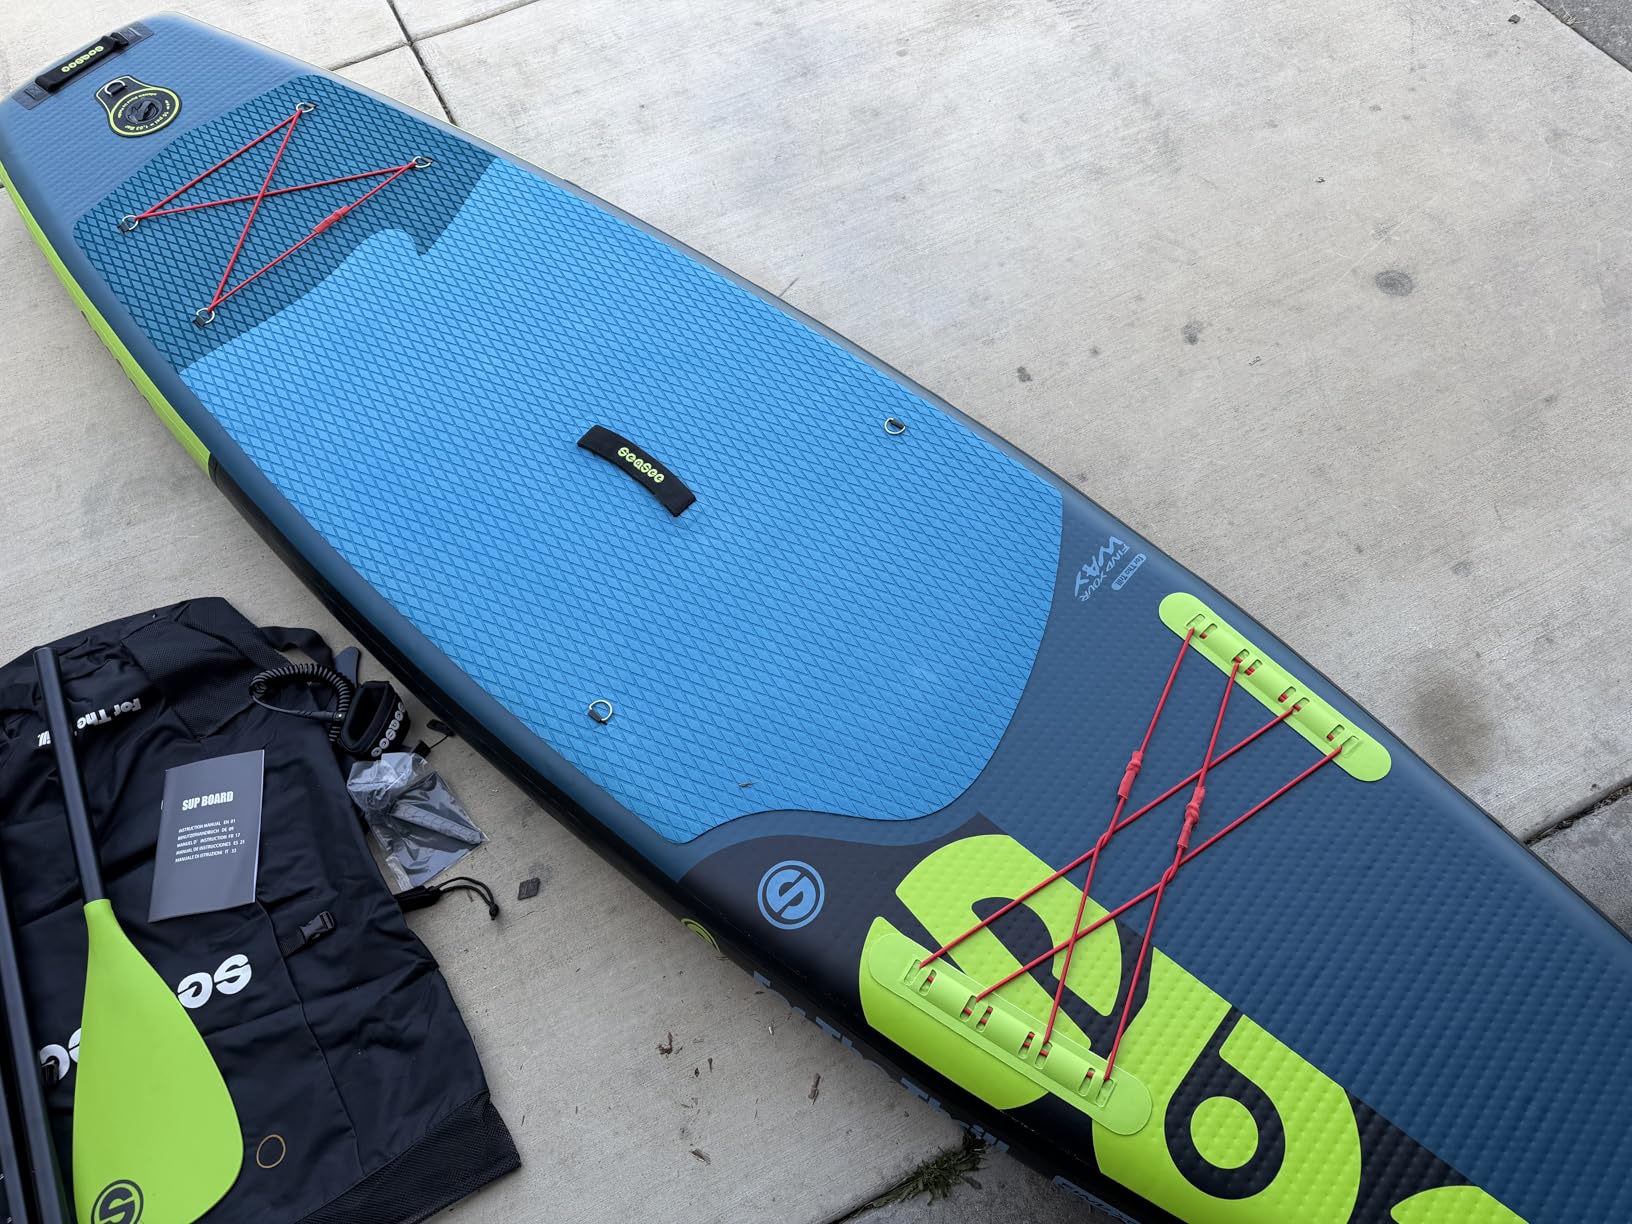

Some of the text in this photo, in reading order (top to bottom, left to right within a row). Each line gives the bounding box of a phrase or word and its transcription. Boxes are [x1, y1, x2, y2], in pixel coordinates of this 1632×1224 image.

[1075, 535, 1124, 597] WAY
[1080, 543, 1130, 601] FIND YOUR
[113, 698, 142, 716] For
[77, 709, 112, 729] The
[182, 791, 234, 811] SUP BOARD
[178, 824, 203, 833] INSTRUCTION
[203, 820, 221, 828] MANUAL
[200, 835, 228, 843] INSTRUCTION
[175, 855, 195, 863] MANUALE
